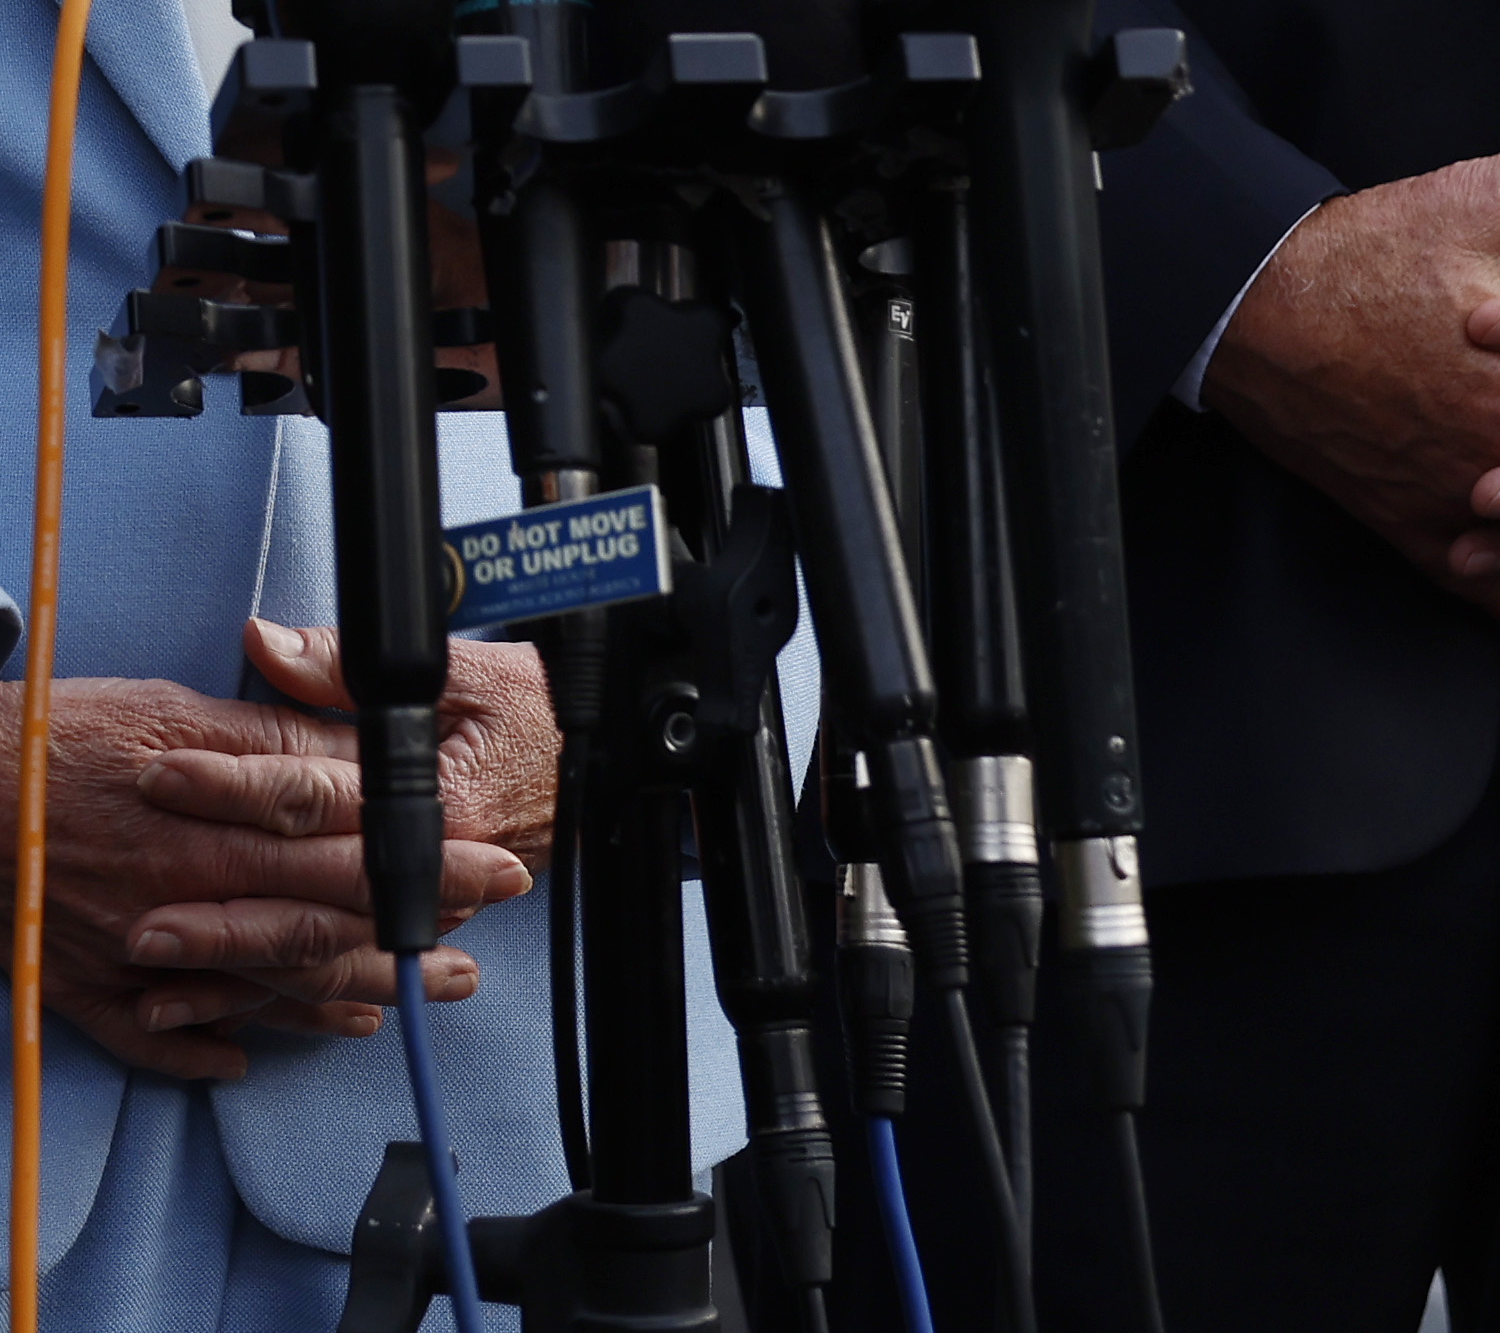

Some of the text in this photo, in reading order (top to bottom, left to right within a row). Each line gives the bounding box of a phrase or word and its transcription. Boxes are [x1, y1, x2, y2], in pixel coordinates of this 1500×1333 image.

[462, 505, 646, 561] DO NOT MOVE
[474, 557, 515, 584] OR
[523, 534, 640, 573] UNPLUG
